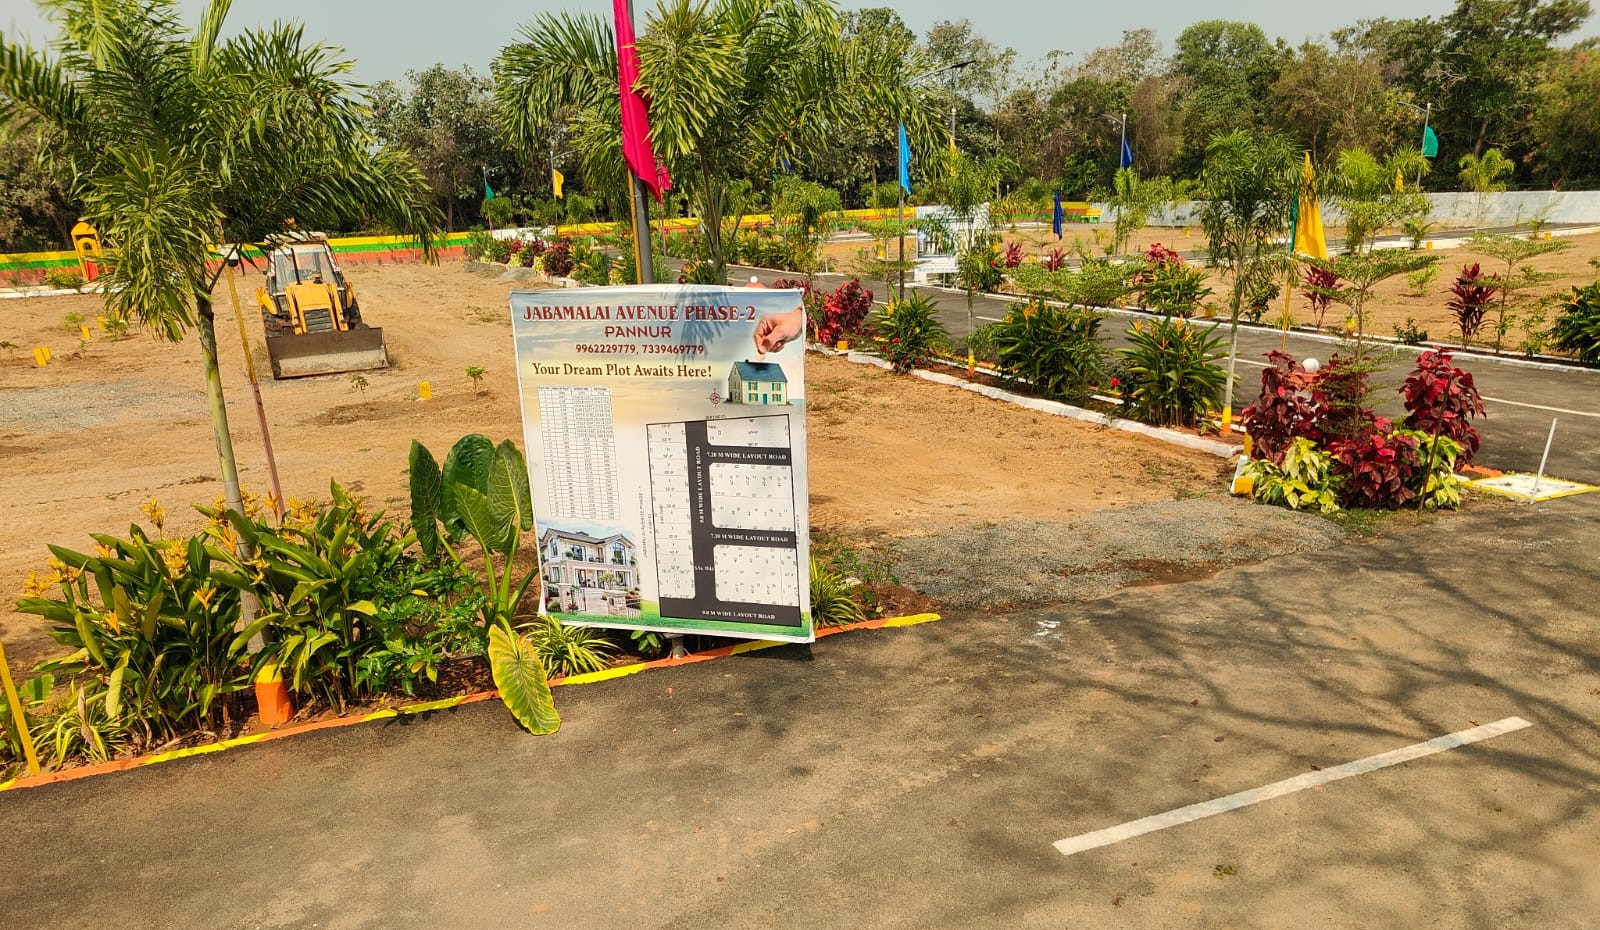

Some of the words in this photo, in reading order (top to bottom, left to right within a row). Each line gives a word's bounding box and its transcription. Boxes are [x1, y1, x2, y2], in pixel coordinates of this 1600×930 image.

[523, 305, 610, 321] JABAMALAI
[615, 305, 679, 321] AVENUE
[684, 305, 757, 321] PHASE-2
[604, 325, 672, 338] PANNUR
[575, 343, 639, 355] 9962229779,
[642, 344, 705, 355] 7339469779
[532, 362, 561, 375] Your
[563, 363, 603, 376] Dream
[606, 363, 631, 376] Plot
[634, 364, 674, 377] Awaits
[677, 364, 712, 378] Here!
[745, 534, 769, 542] LAYOUT
[770, 535, 789, 543] ROAD
